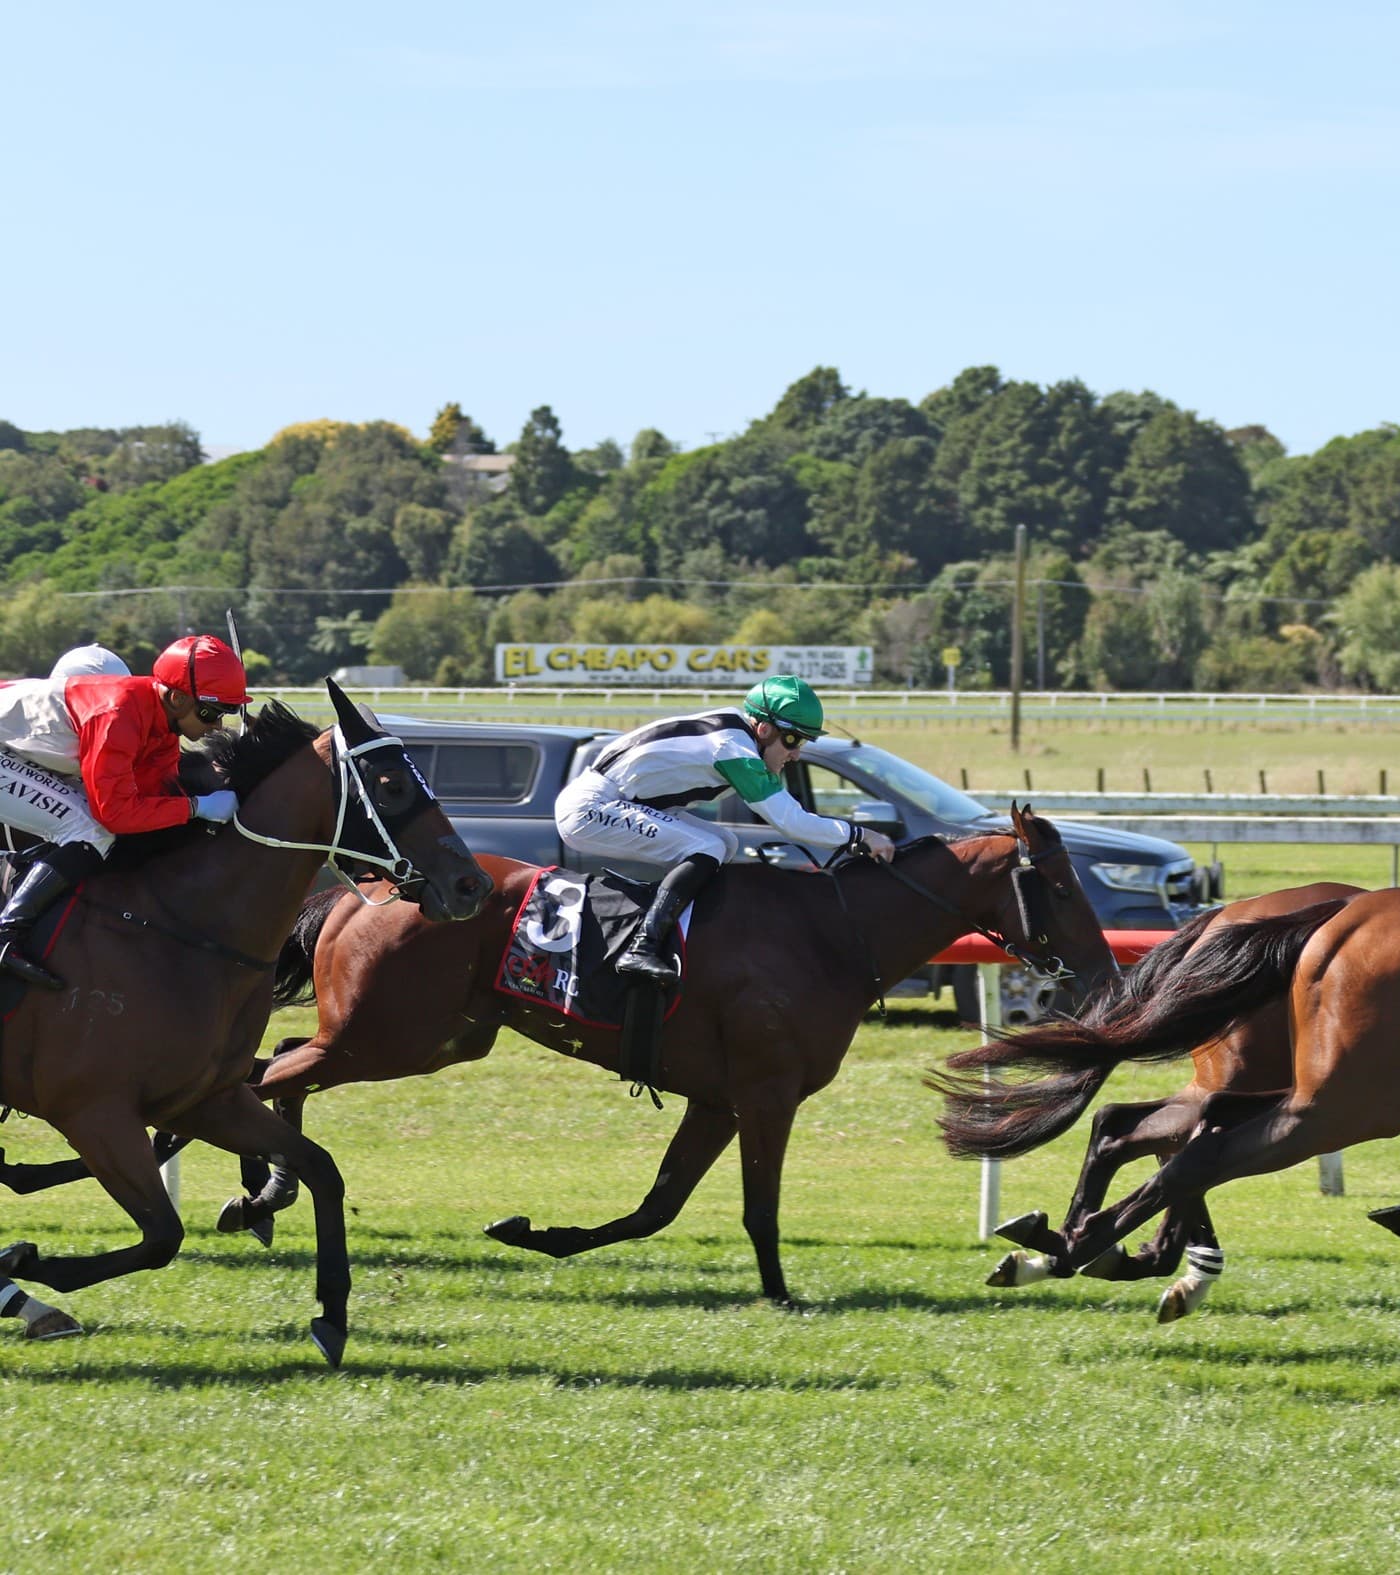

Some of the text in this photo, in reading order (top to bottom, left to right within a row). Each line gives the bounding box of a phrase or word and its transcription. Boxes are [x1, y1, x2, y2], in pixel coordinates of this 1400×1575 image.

[504, 645, 544, 678] EL
[547, 646, 678, 672] CHEAPO
[687, 647, 771, 673] CARS
[0, 756, 70, 796] QUIWORLD
[0, 776, 72, 820] AVISH
[526, 878, 587, 953] 3
